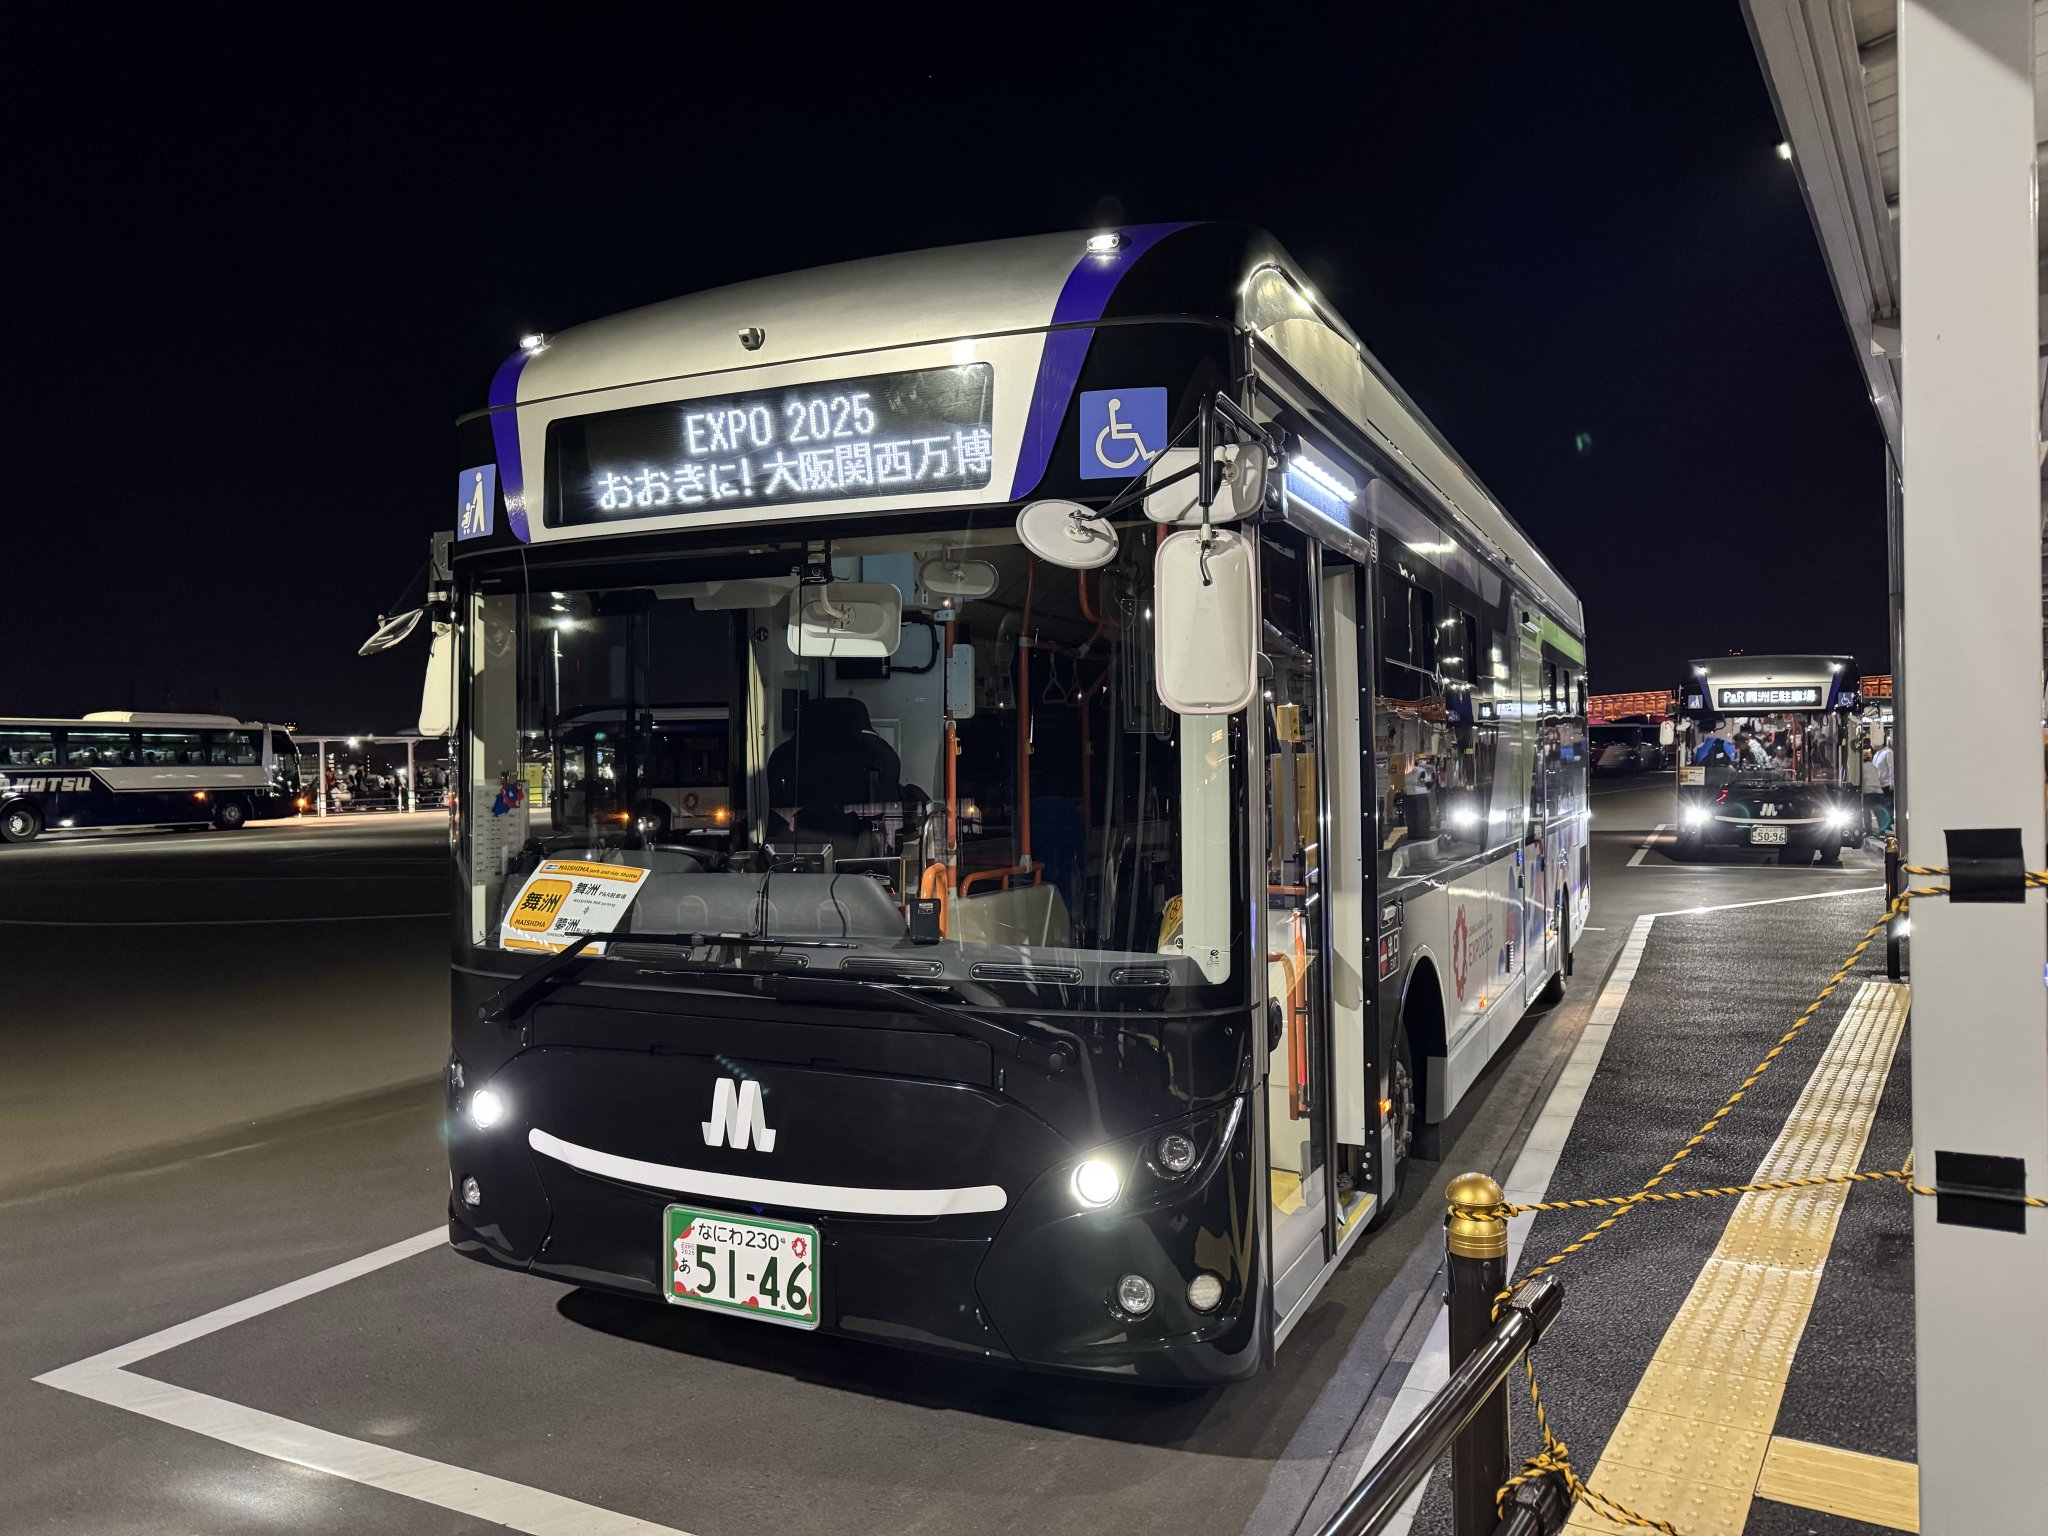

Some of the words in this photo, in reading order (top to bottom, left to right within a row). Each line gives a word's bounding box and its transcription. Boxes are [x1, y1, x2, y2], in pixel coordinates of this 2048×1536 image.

[686, 406, 772, 454] EXPO
[786, 393, 876, 443] 2025
[15, 776, 92, 793] KOTSU
[558, 864, 589, 873] MAISHIMA
[573, 882, 602, 896] 舞洲
[520, 891, 563, 914] 舞洲
[515, 918, 546, 928] MAISHIMA
[554, 917, 581, 932] 夢洲
[678, 1257, 691, 1275] あ
[696, 1243, 808, 1311] 51-46
